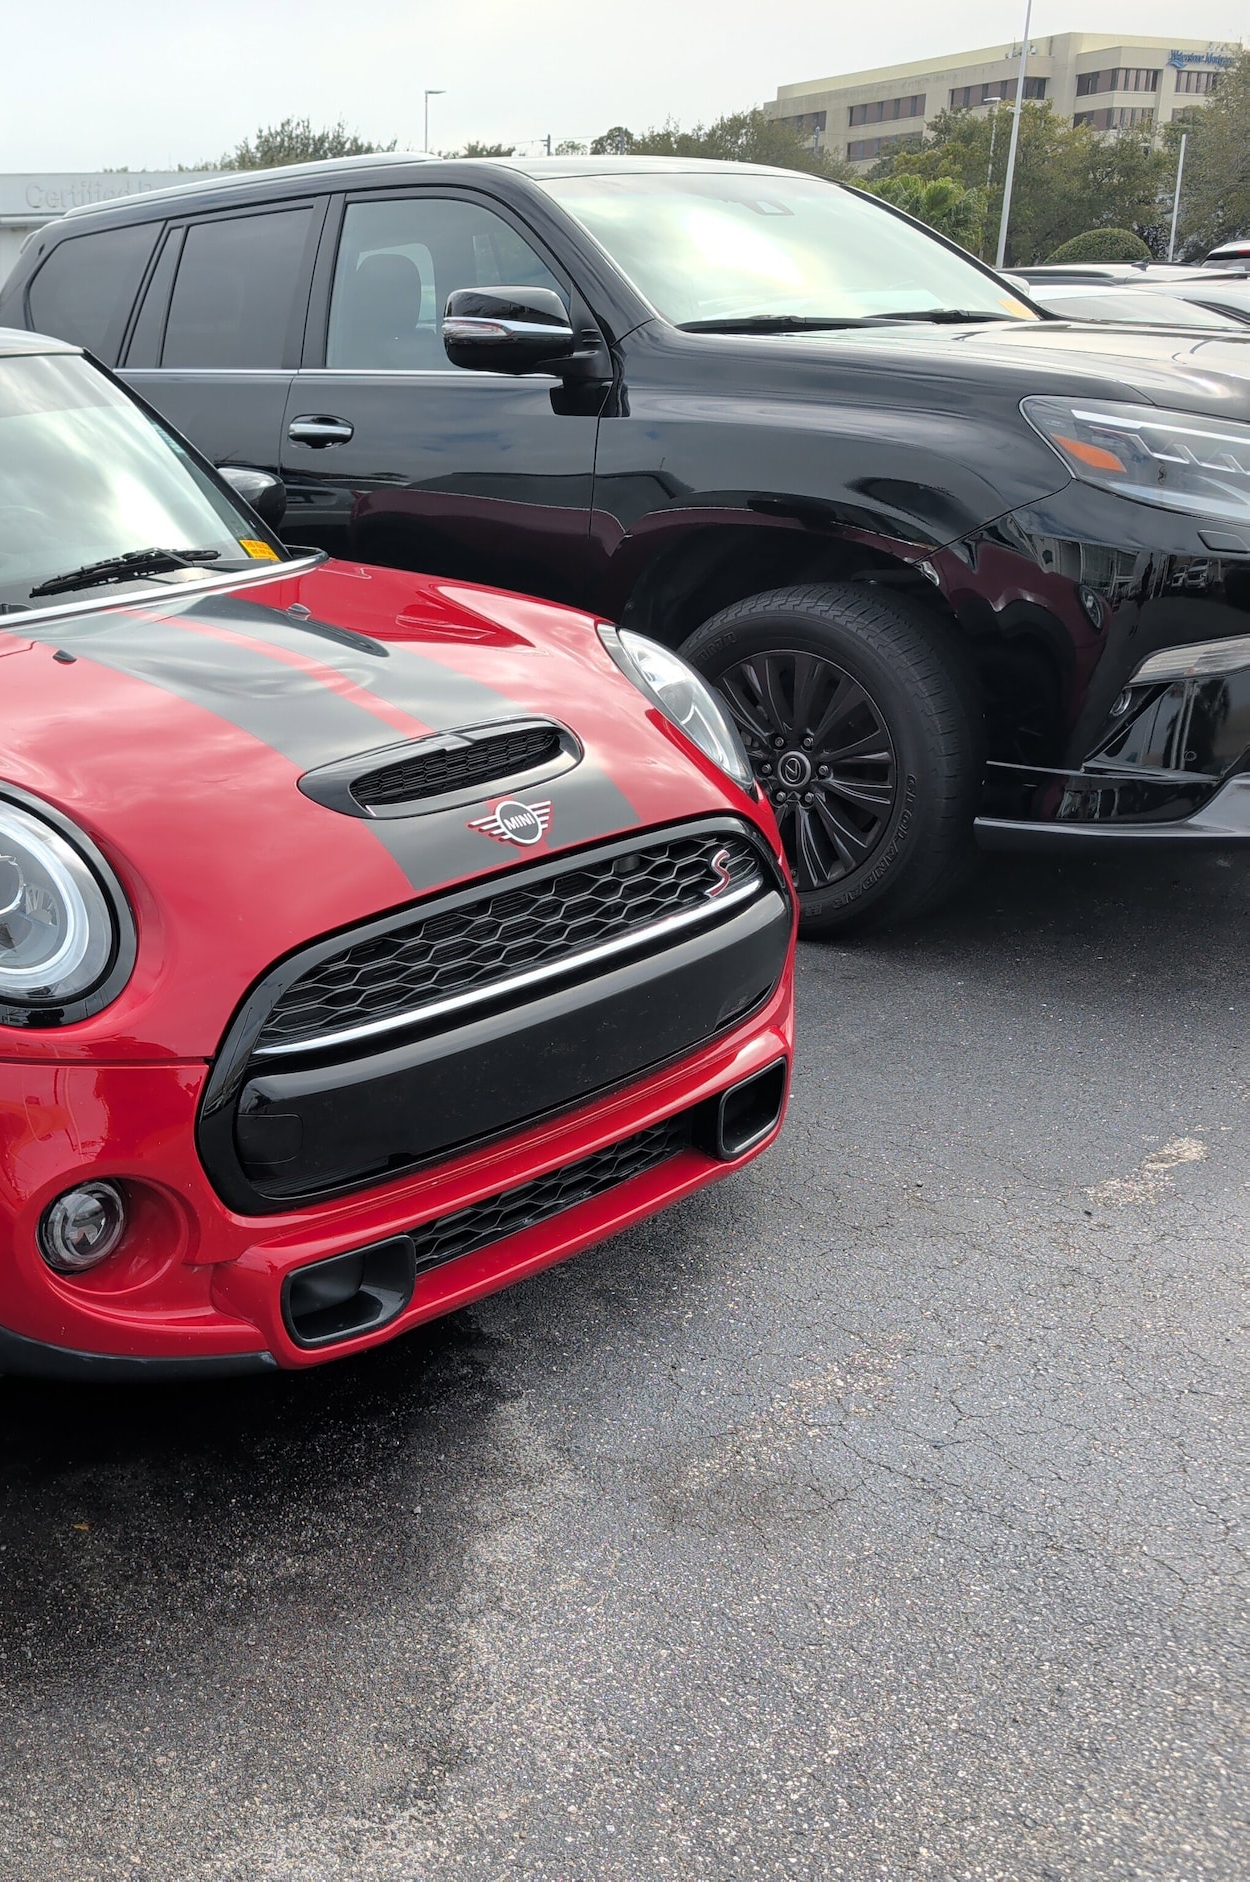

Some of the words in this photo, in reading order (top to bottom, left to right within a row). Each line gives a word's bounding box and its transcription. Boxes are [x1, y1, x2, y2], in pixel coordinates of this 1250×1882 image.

[25, 180, 130, 209] Certified
[503, 812, 536, 830] MINI
[704, 849, 731, 897] S
